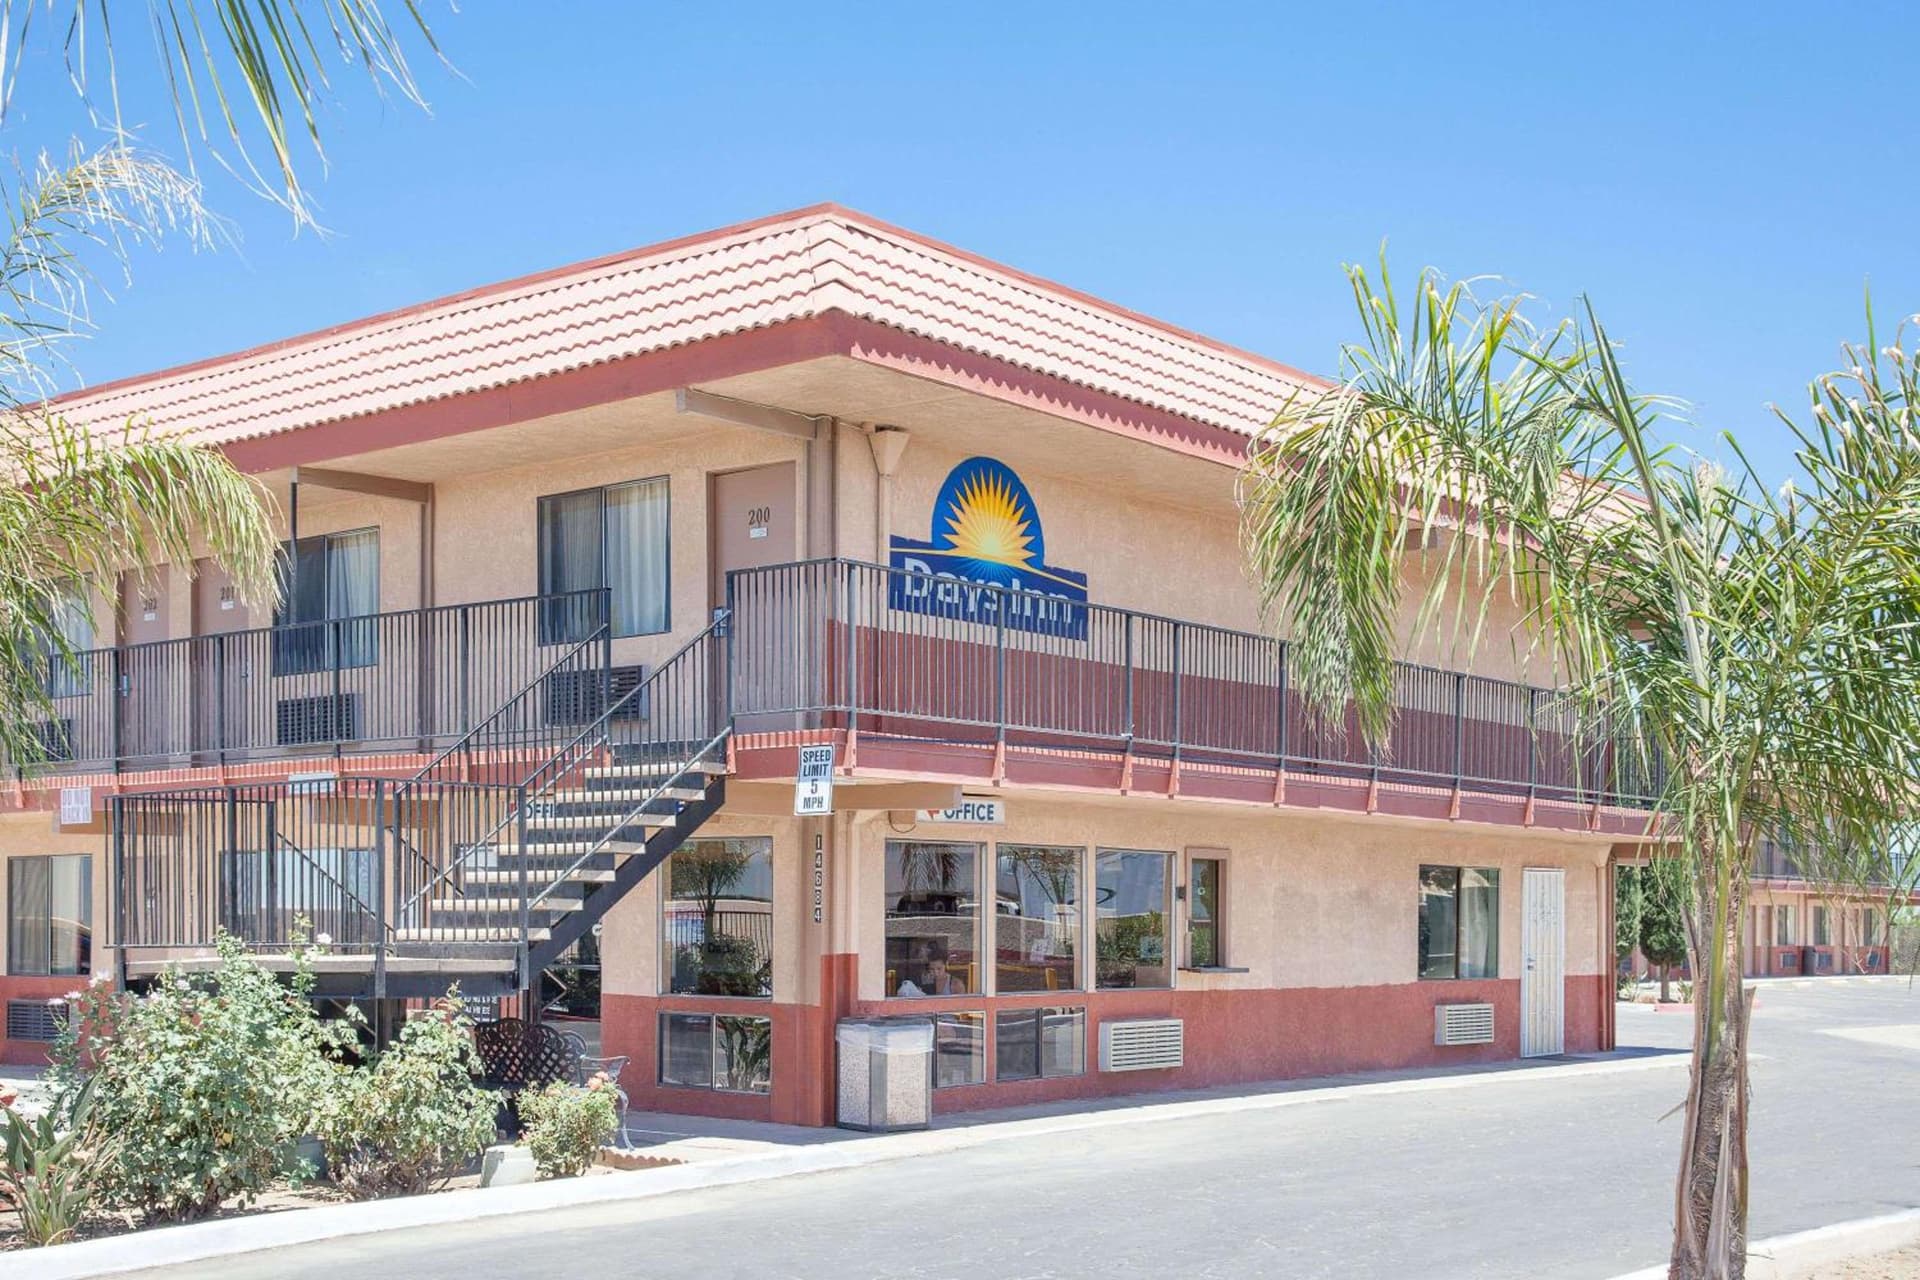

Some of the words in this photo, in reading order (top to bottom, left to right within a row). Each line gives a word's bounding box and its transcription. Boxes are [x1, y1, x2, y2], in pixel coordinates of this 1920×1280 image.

[748, 506, 770, 526] 200
[904, 557, 1004, 613] Days
[1011, 578, 1072, 623] Inn
[803, 750, 831, 763] SPEED
[803, 764, 829, 777] LIMIT
[811, 778, 818, 794] 5
[803, 796, 823, 809] MPH
